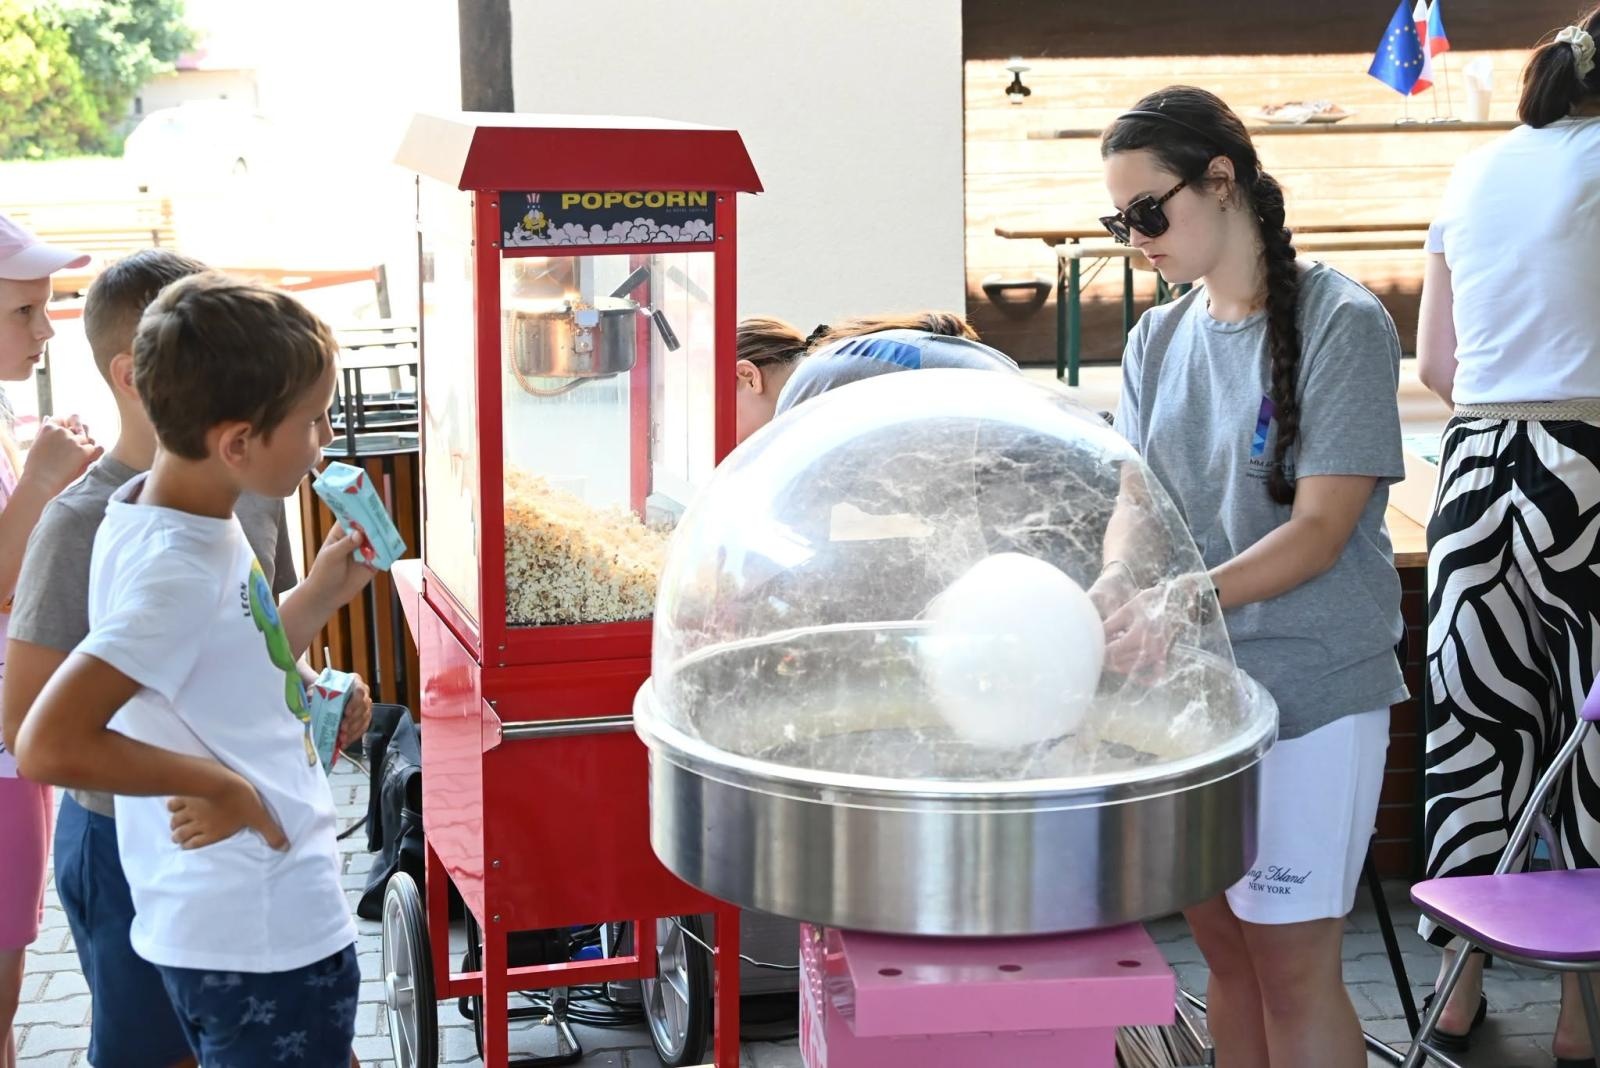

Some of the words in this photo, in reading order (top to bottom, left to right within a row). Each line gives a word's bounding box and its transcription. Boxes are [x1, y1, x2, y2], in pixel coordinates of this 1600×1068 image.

[561, 191, 708, 209] POPCORN
[240, 582, 251, 617] LEON
[1265, 865, 1312, 884] Island
[1248, 881, 1265, 892] NEW
[1267, 885, 1291, 894] YORK
